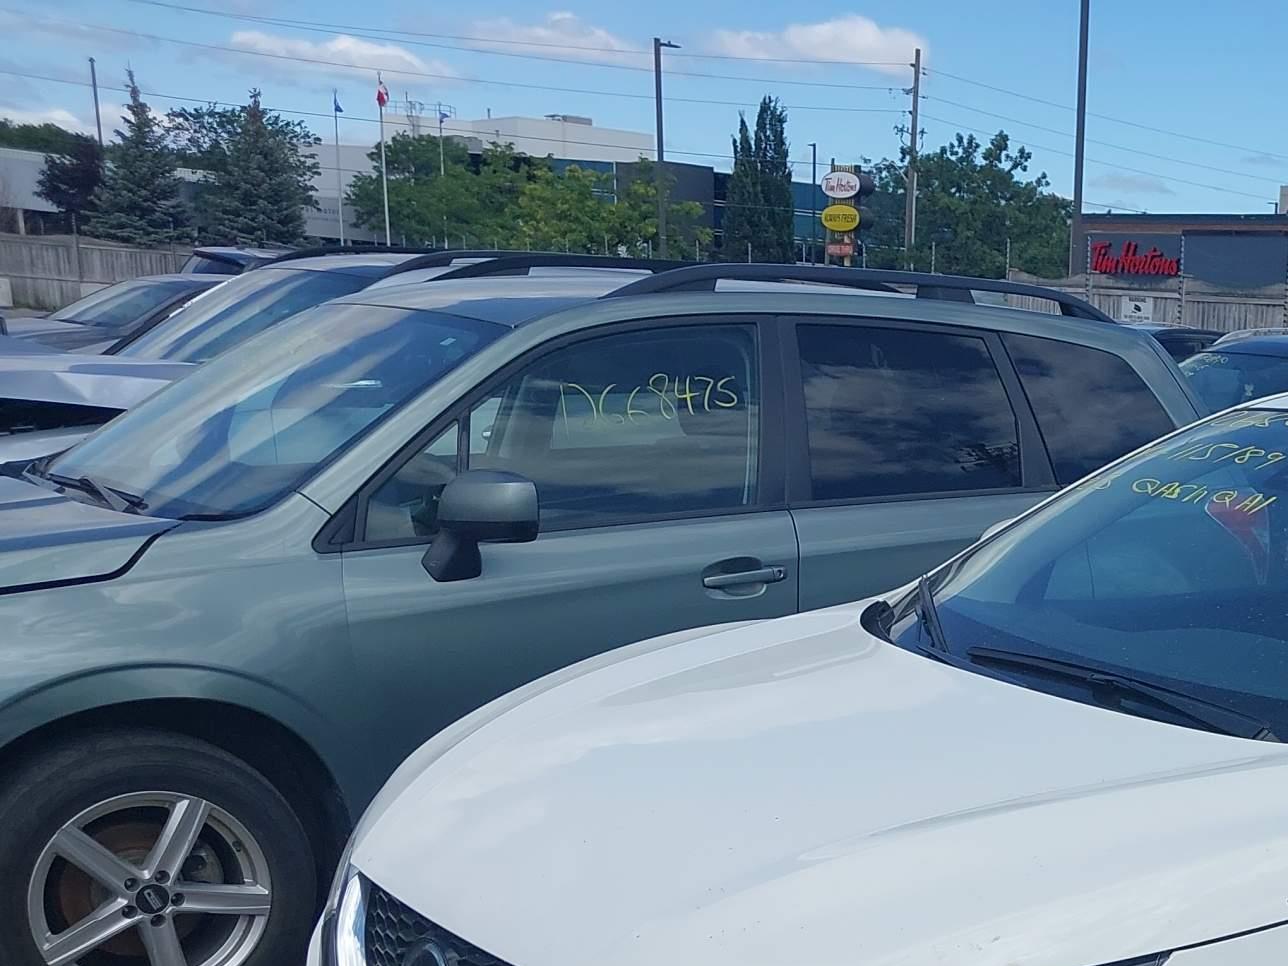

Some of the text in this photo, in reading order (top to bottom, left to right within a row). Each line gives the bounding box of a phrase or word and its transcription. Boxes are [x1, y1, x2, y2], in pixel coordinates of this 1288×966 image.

[836, 176, 857, 193] Hortons
[1092, 240, 1179, 276] Tim Hortons
